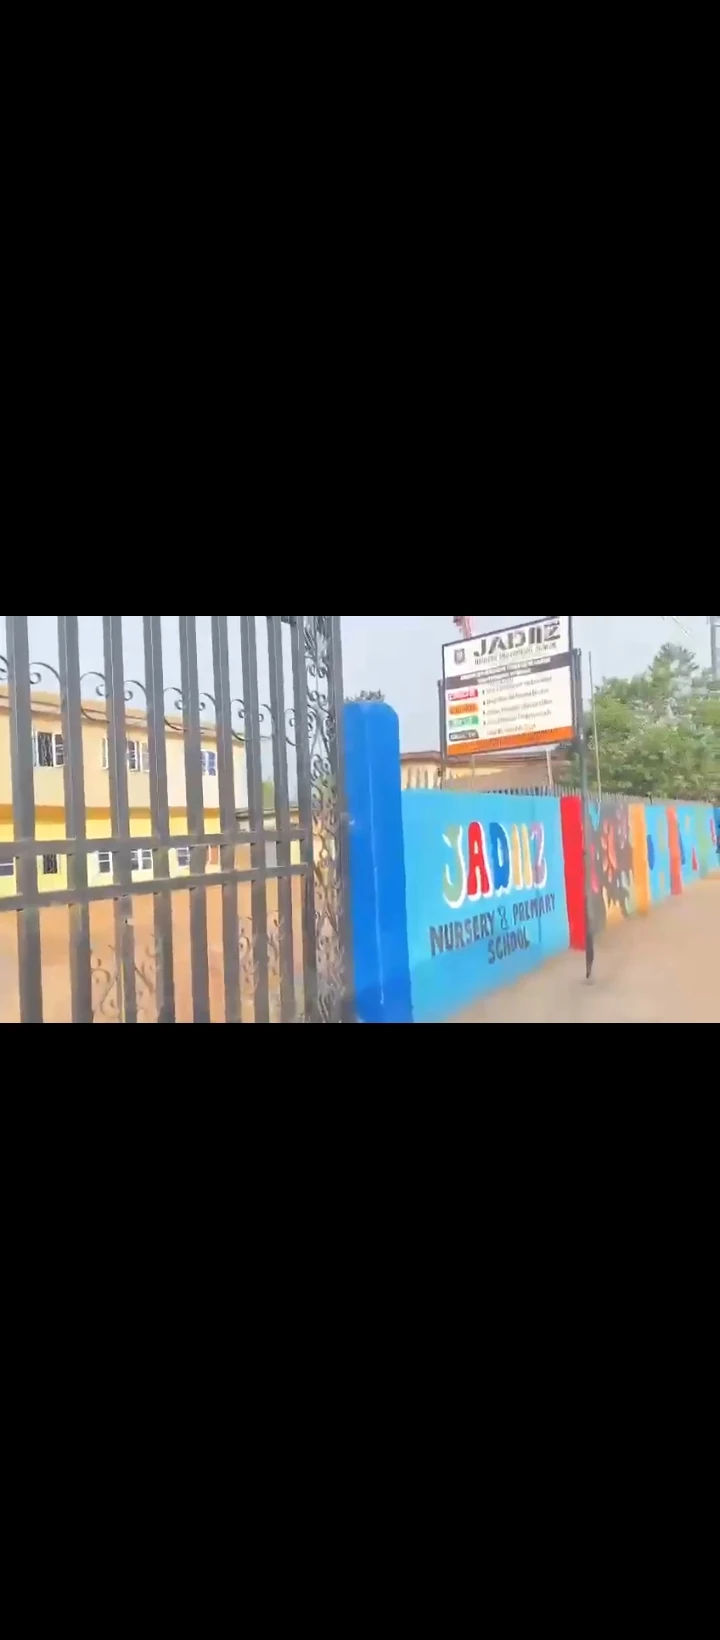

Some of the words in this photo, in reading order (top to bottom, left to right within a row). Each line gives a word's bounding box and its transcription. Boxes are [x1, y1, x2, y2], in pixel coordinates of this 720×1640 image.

[429, 909, 495, 957] NURSERY
[512, 892, 556, 926] PRIMARY
[487, 926, 530, 965] SCHOOL
